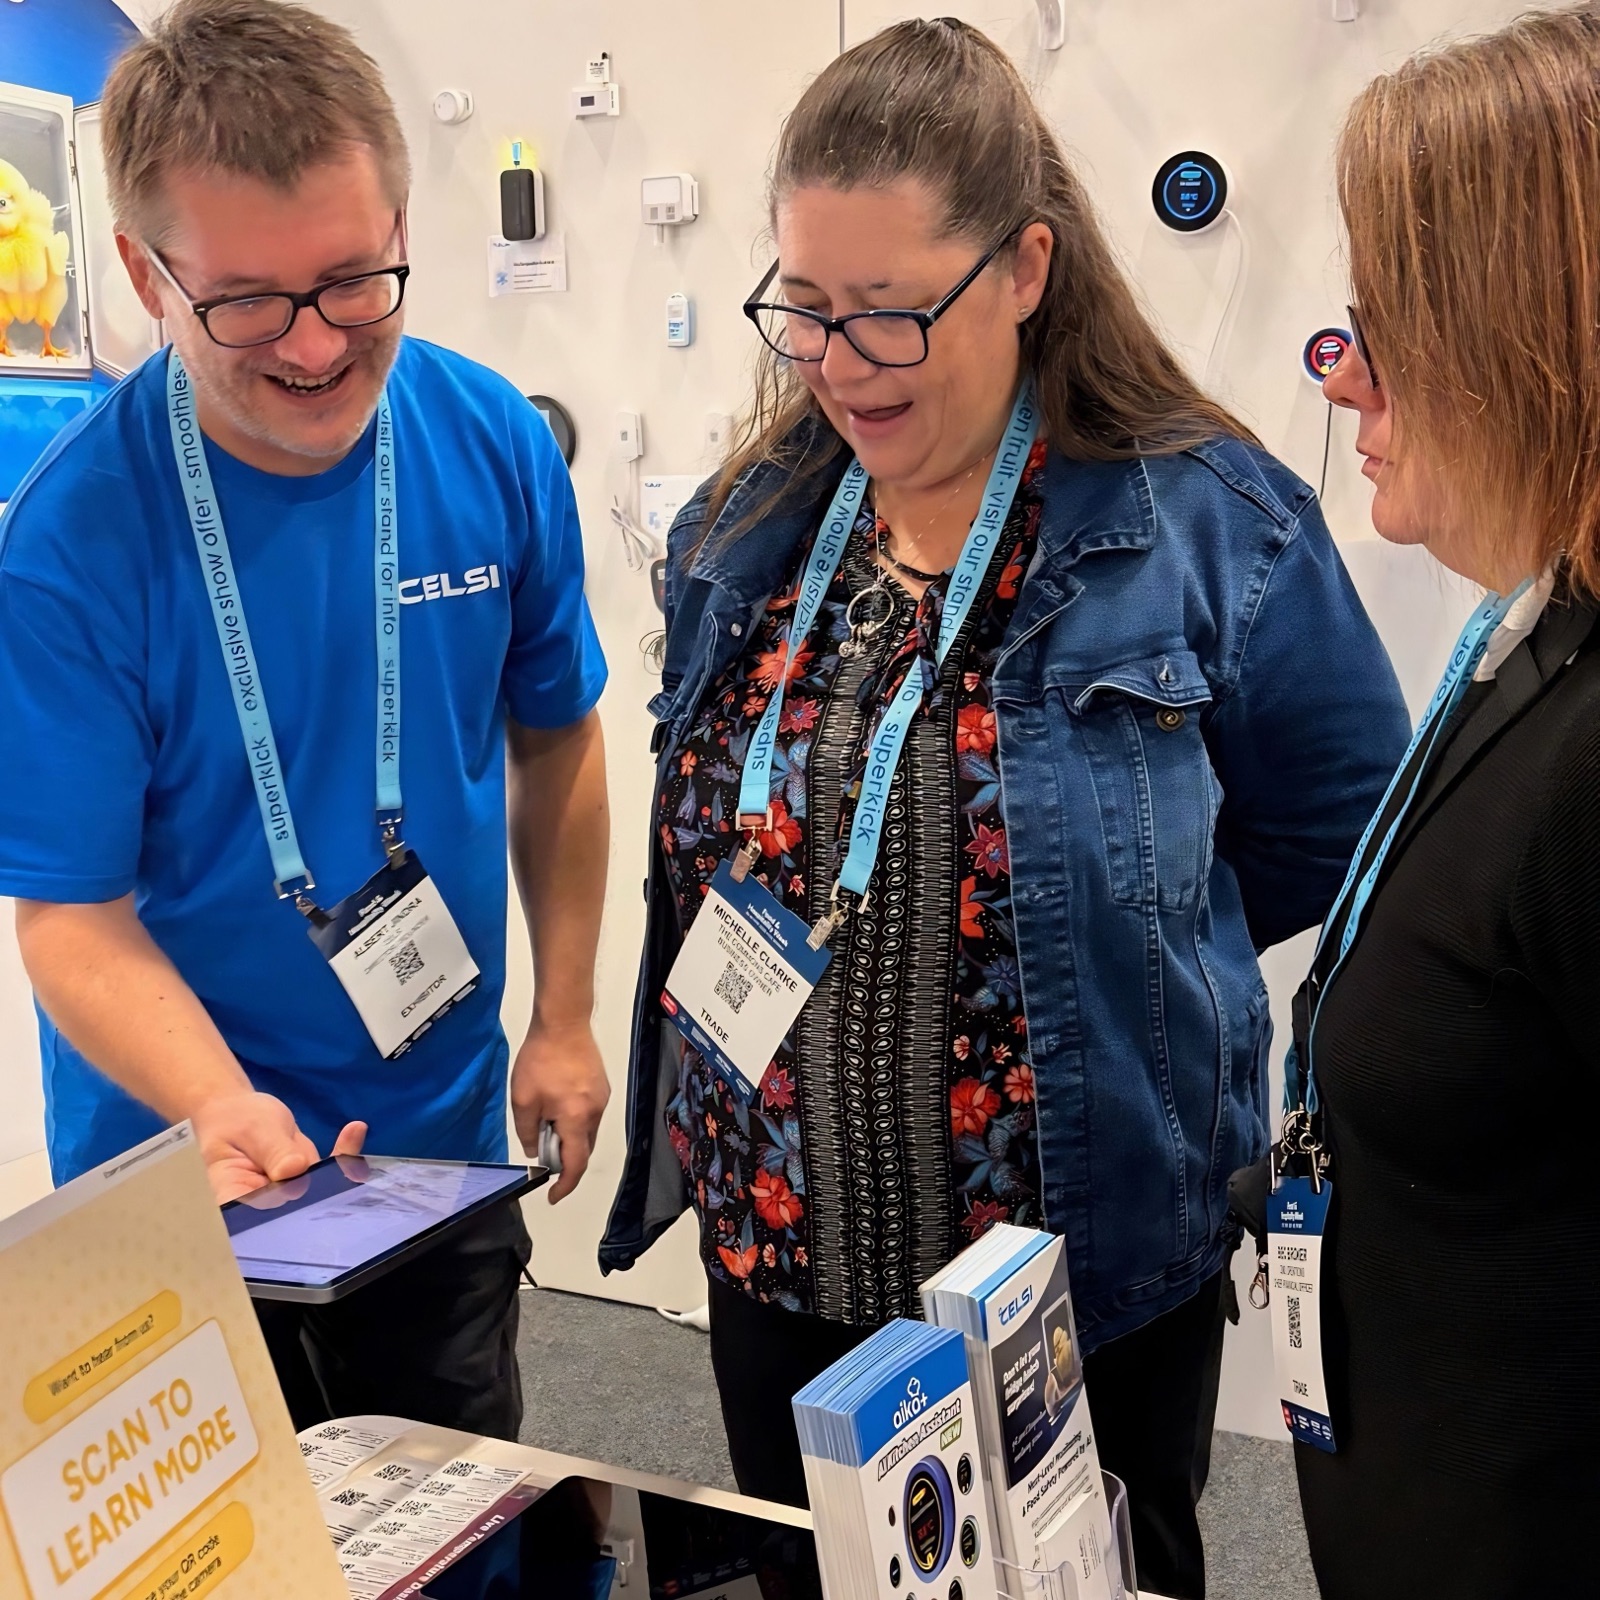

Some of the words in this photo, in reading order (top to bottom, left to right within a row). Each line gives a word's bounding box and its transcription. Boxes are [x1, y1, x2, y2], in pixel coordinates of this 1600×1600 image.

[379, 408, 392, 449] visit
[380, 454, 391, 492] our
[999, 438, 1028, 479] fruit
[193, 496, 219, 547] offer
[380, 497, 395, 555] stand
[822, 505, 851, 558] show
[980, 490, 1007, 533] visit
[381, 561, 396, 592] for
[959, 533, 989, 572] our
[206, 551, 235, 609] show
[398, 564, 501, 605] CELSI
[382, 597, 397, 635] info
[224, 615, 258, 711] exclusive
[1437, 635, 1471, 701] offer
[380, 658, 400, 763] superkick
[251, 736, 290, 841] superkick
[855, 721, 900, 847] superkick
[713, 904, 760, 954] MICHELLE
[758, 950, 798, 993] CLARKE
[701, 1007, 730, 1044] TRADE
[62, 1407, 151, 1502] SCAN
[149, 1377, 193, 1431] TO
[46, 1472, 154, 1586] LEARN
[152, 1404, 237, 1498] MORE
